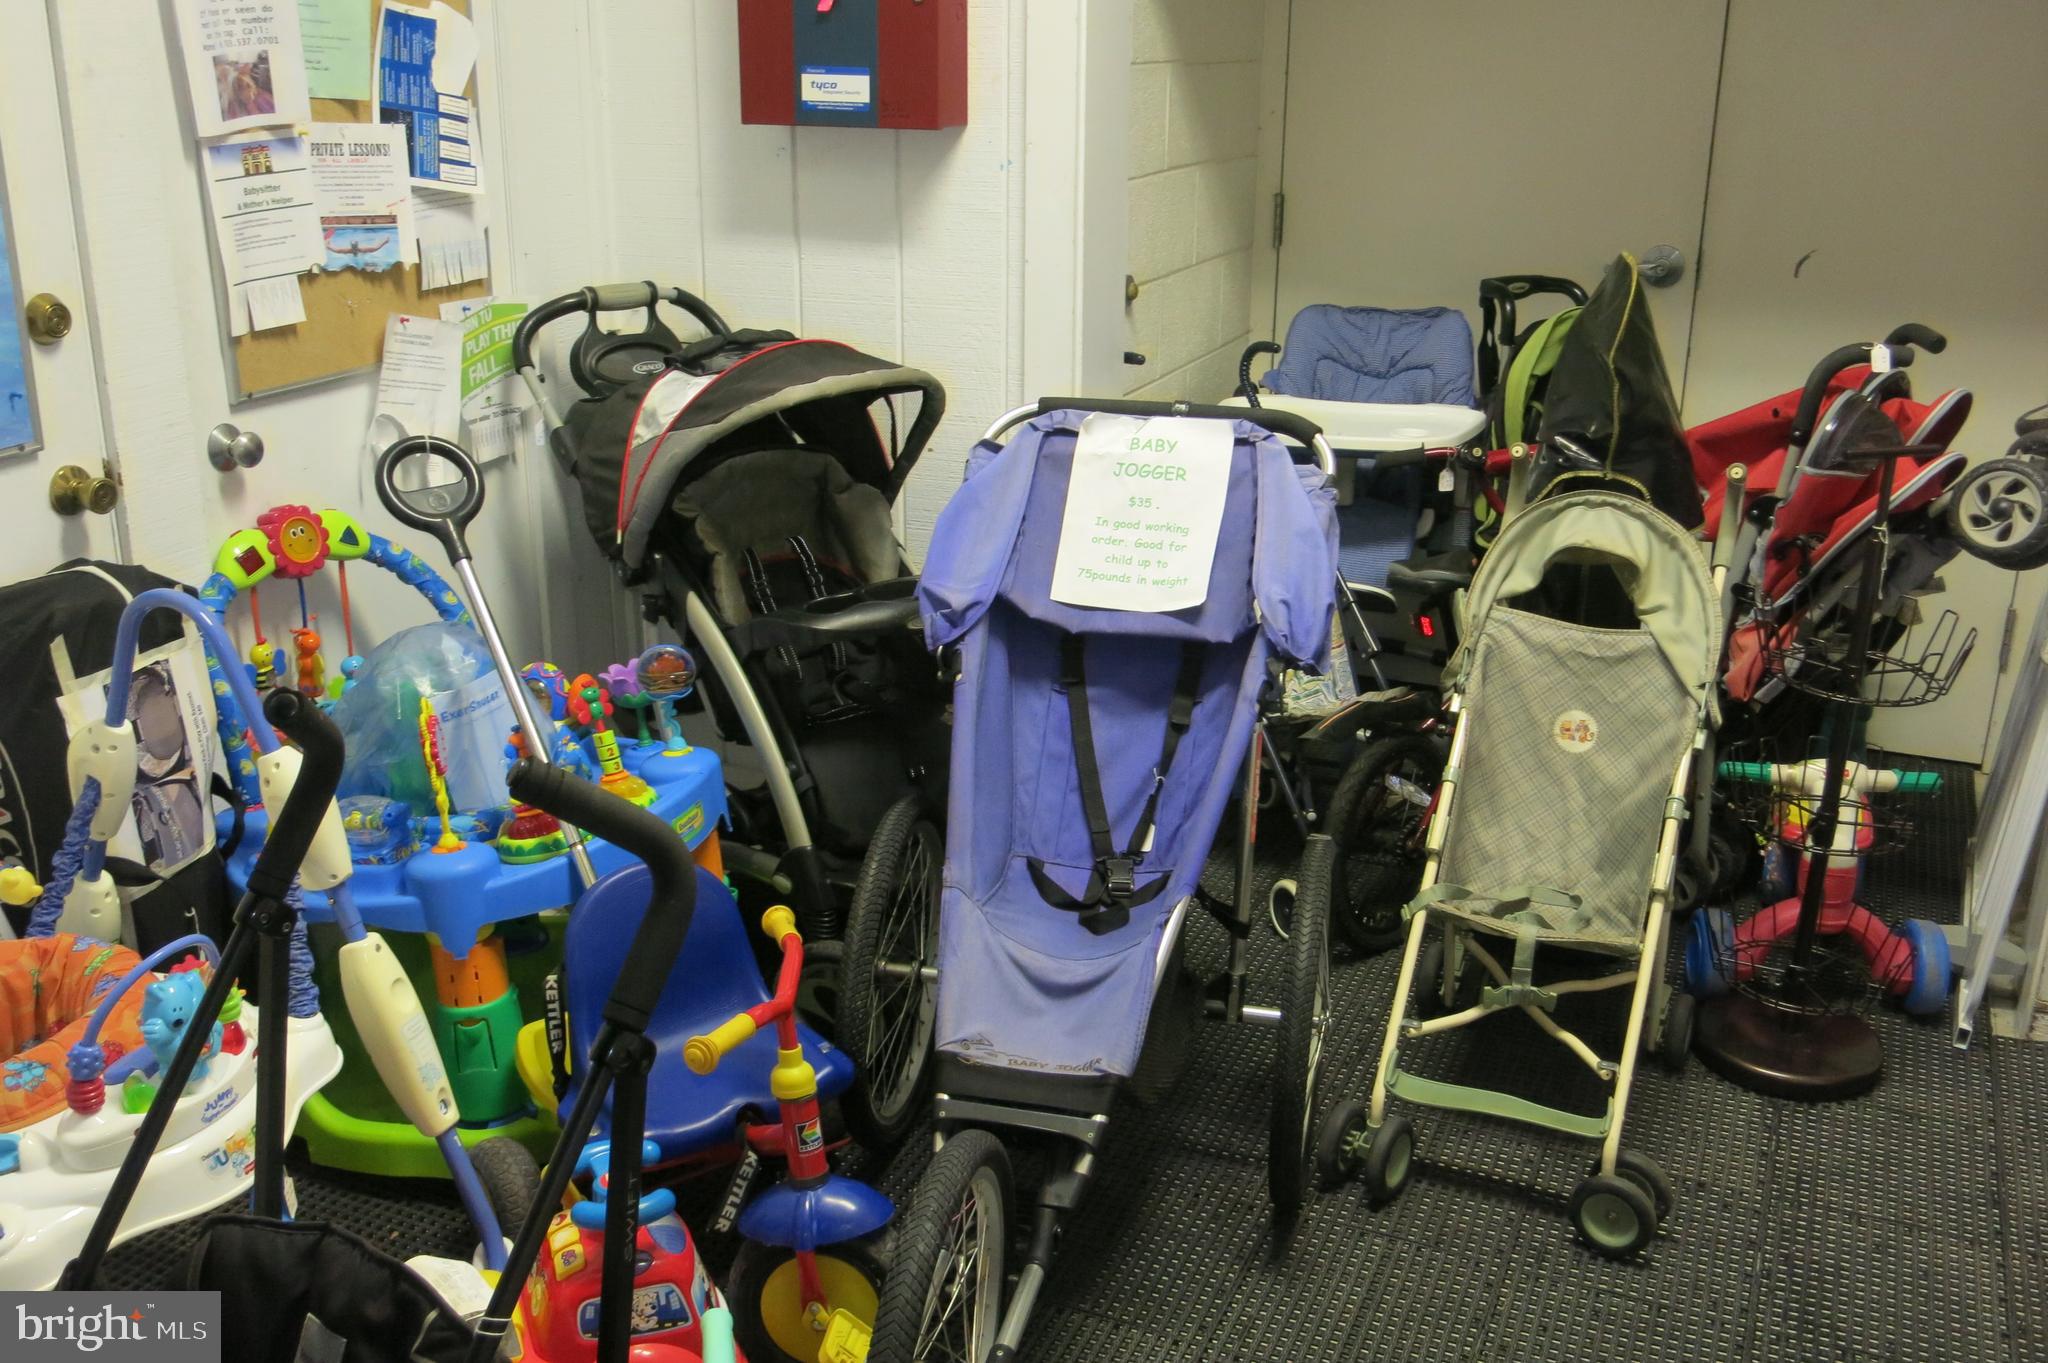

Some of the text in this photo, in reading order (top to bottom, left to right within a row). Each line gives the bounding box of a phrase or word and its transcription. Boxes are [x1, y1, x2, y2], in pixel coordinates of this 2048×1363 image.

[810, 80, 838, 91] tyco
[310, 142, 391, 157] PRIVATE LESSONS!
[243, 184, 281, 196] Babysitter
[465, 332, 491, 358] PLAY
[1129, 437, 1179, 454] BABY
[1112, 461, 1187, 482] JOGGER
[1094, 516, 1190, 537] In good working
[1091, 535, 1188, 552] order. Good for
[1104, 554, 1169, 569] child up to
[1077, 567, 1189, 589] 75pounds in weight
[599, 735, 605, 745] 1
[606, 746, 616, 757] 2
[613, 761, 621, 771] 3
[544, 974, 564, 1055] KETTLER
[1007, 1058, 1049, 1070] BABY
[713, 1150, 759, 1233] KETTLER
